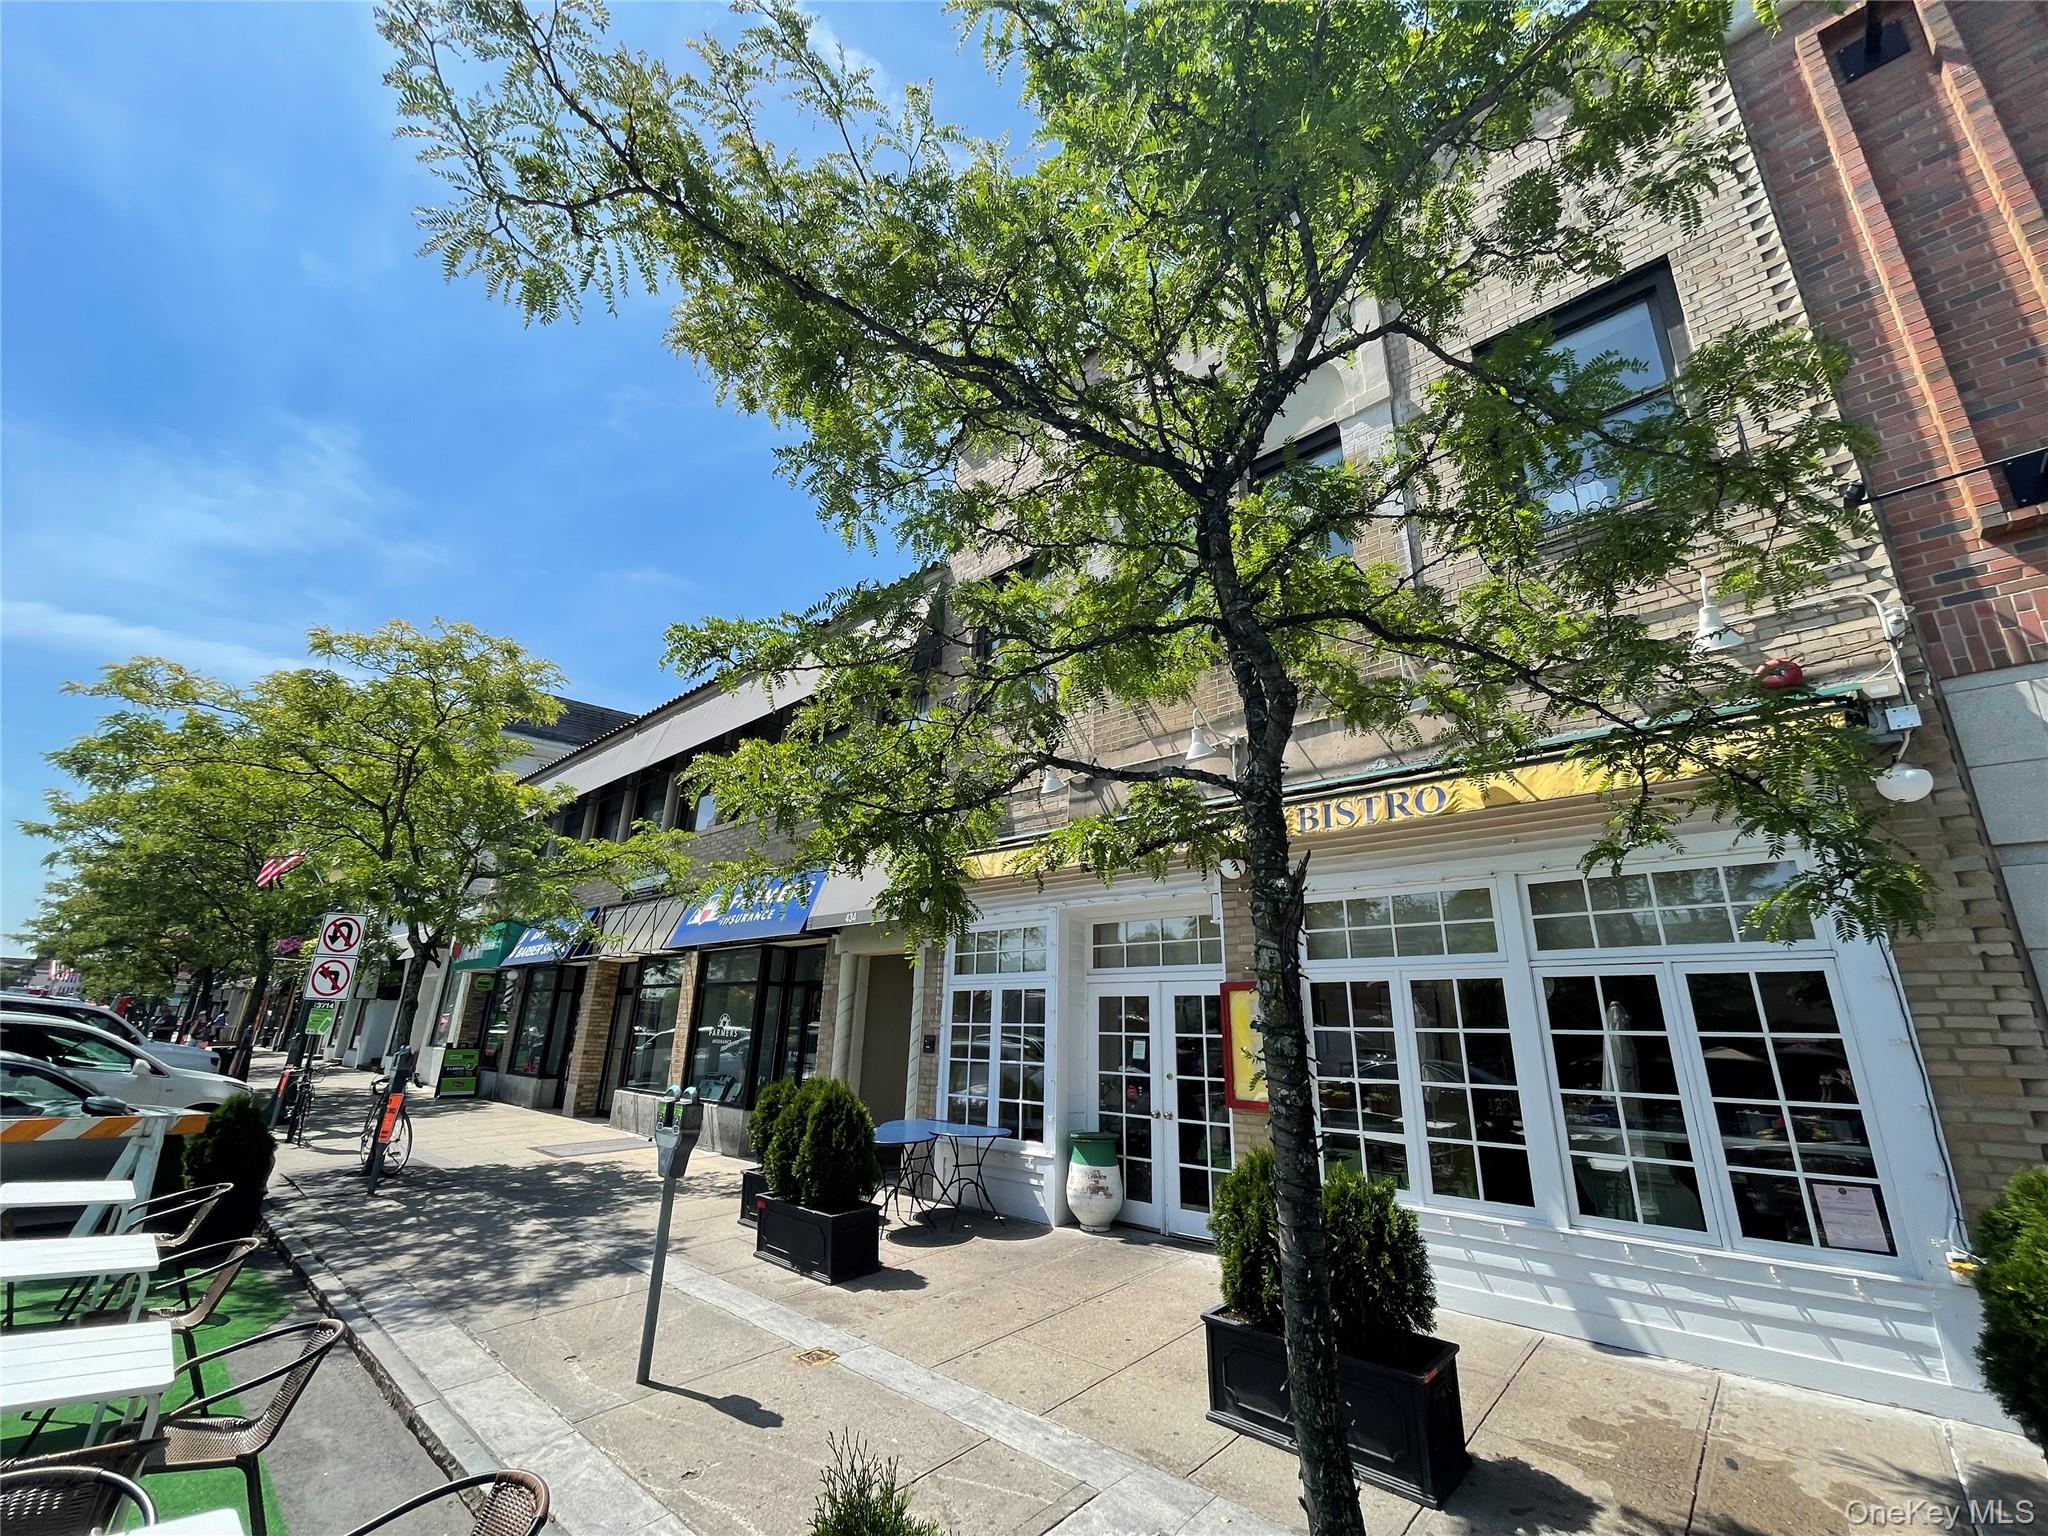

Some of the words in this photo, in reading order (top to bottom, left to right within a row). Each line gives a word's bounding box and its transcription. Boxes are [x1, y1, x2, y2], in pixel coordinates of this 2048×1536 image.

[1299, 786, 1447, 832] BISTRO
[719, 909, 775, 925] INSURANCE
[845, 912, 857, 922] 434
[514, 944, 544, 958] BARBER
[709, 1028, 738, 1037] FARMERS
